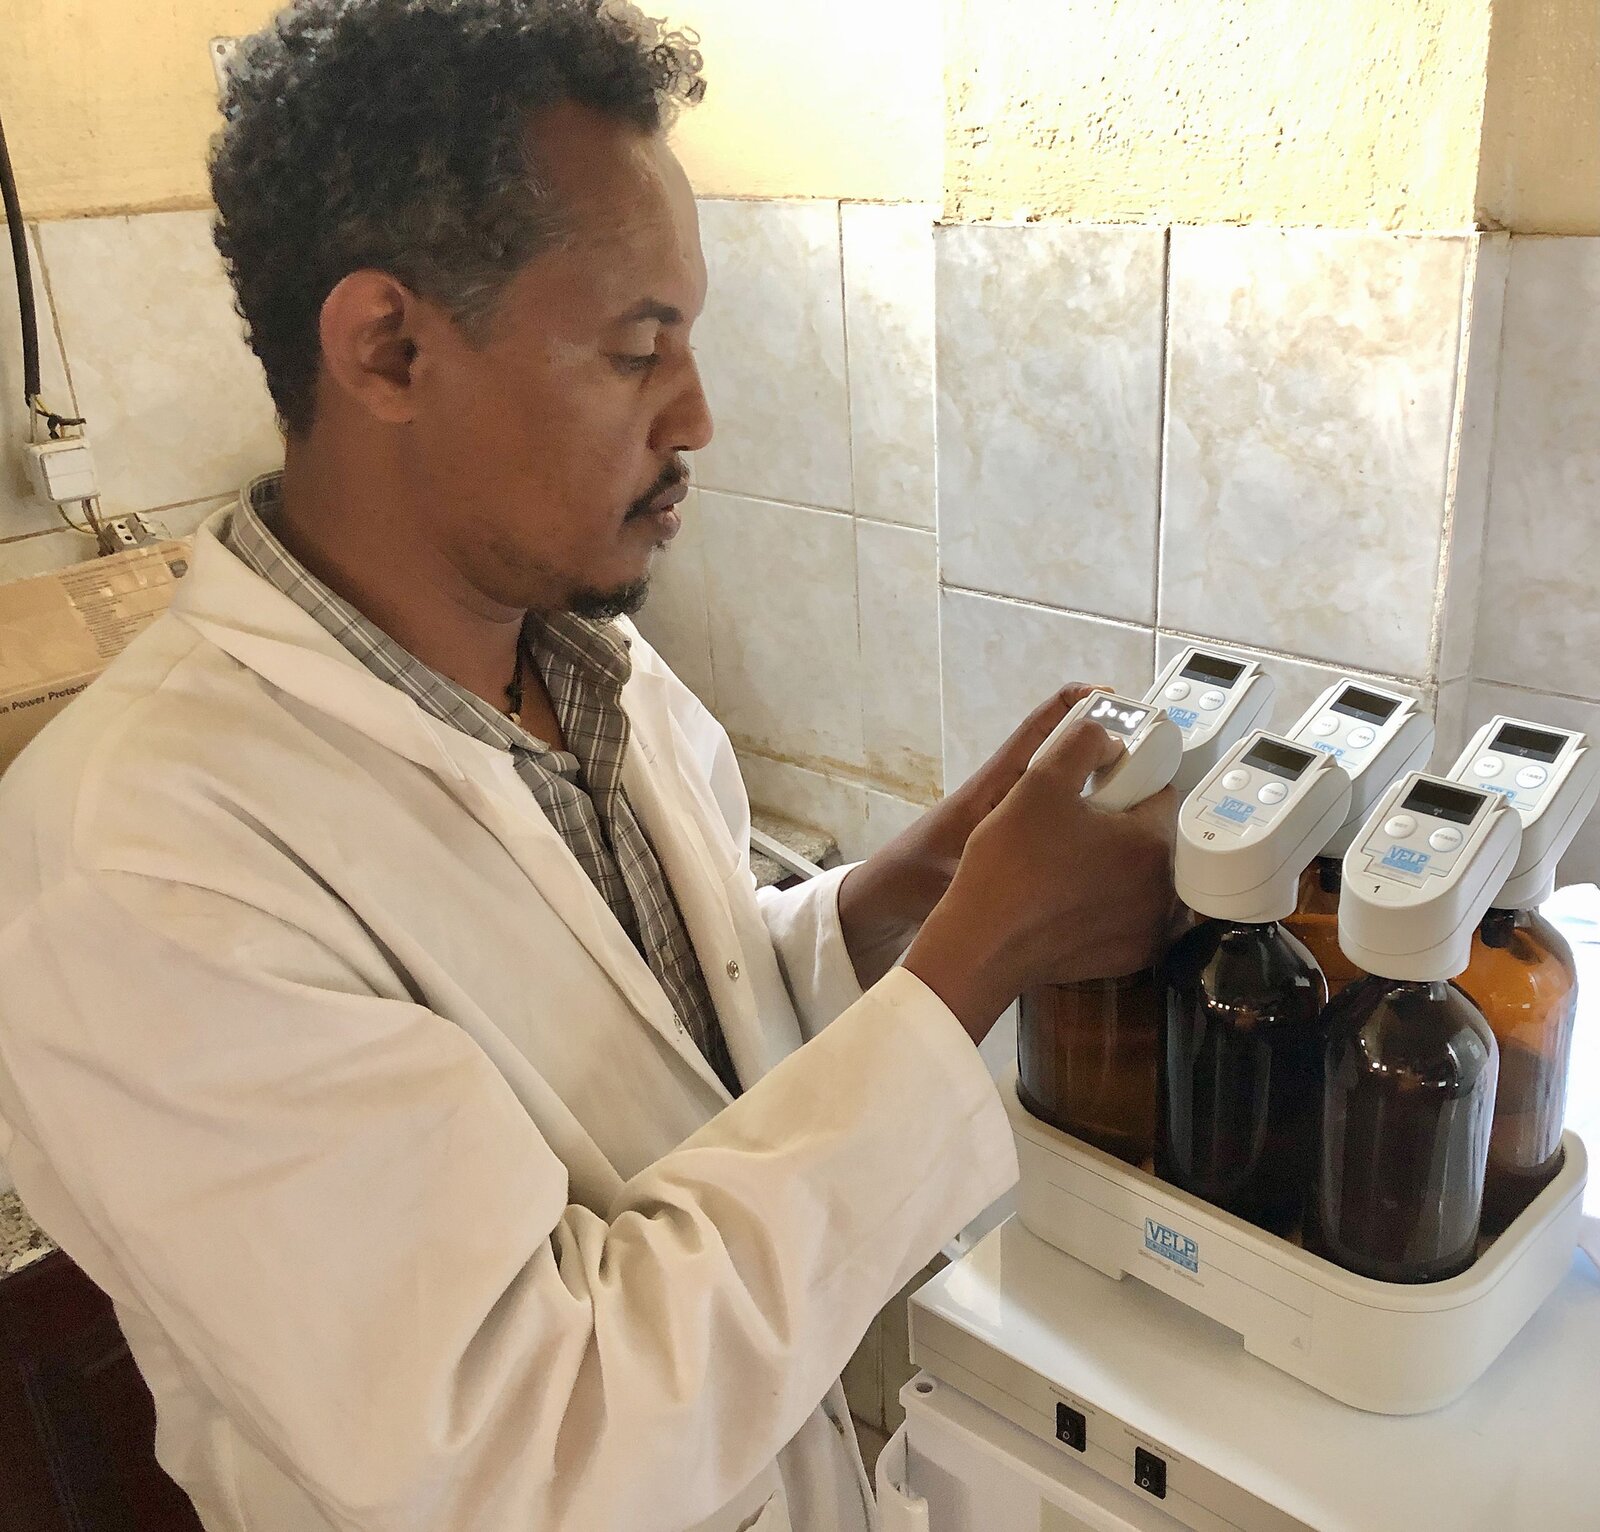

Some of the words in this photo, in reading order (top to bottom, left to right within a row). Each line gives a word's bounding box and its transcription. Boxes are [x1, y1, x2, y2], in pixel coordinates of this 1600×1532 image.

[12, 697, 45, 710] Power
[1222, 796, 1255, 816] VELP
[1202, 831, 1216, 841] 10
[1389, 846, 1428, 865] VELP
[1373, 885, 1381, 893] 1
[1148, 1220, 1196, 1257] VELP
